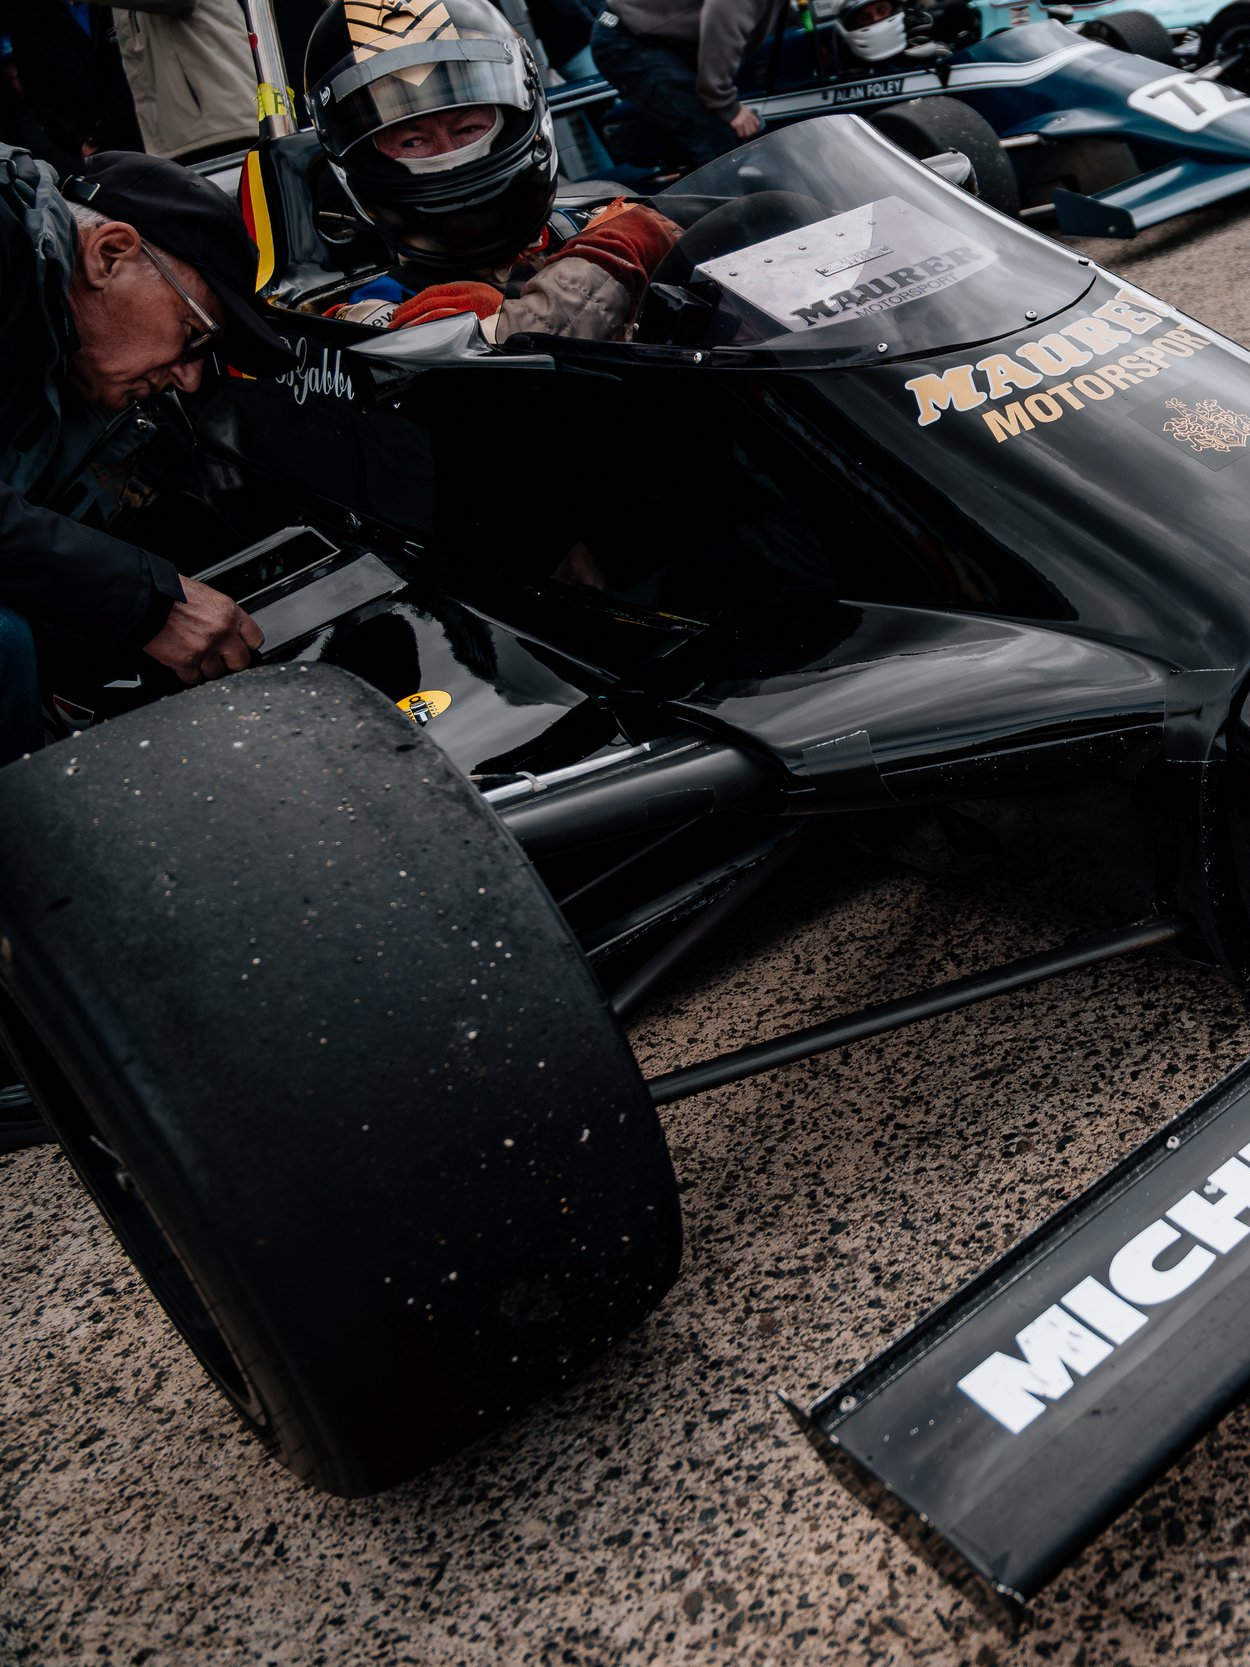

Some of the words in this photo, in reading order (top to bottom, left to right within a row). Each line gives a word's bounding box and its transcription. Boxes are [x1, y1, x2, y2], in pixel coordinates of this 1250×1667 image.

[836, 87, 865, 101] ALAN
[867, 79, 902, 97] FOLEY
[790, 246, 984, 326] MAURER
[855, 273, 959, 318] MOTORSPORT
